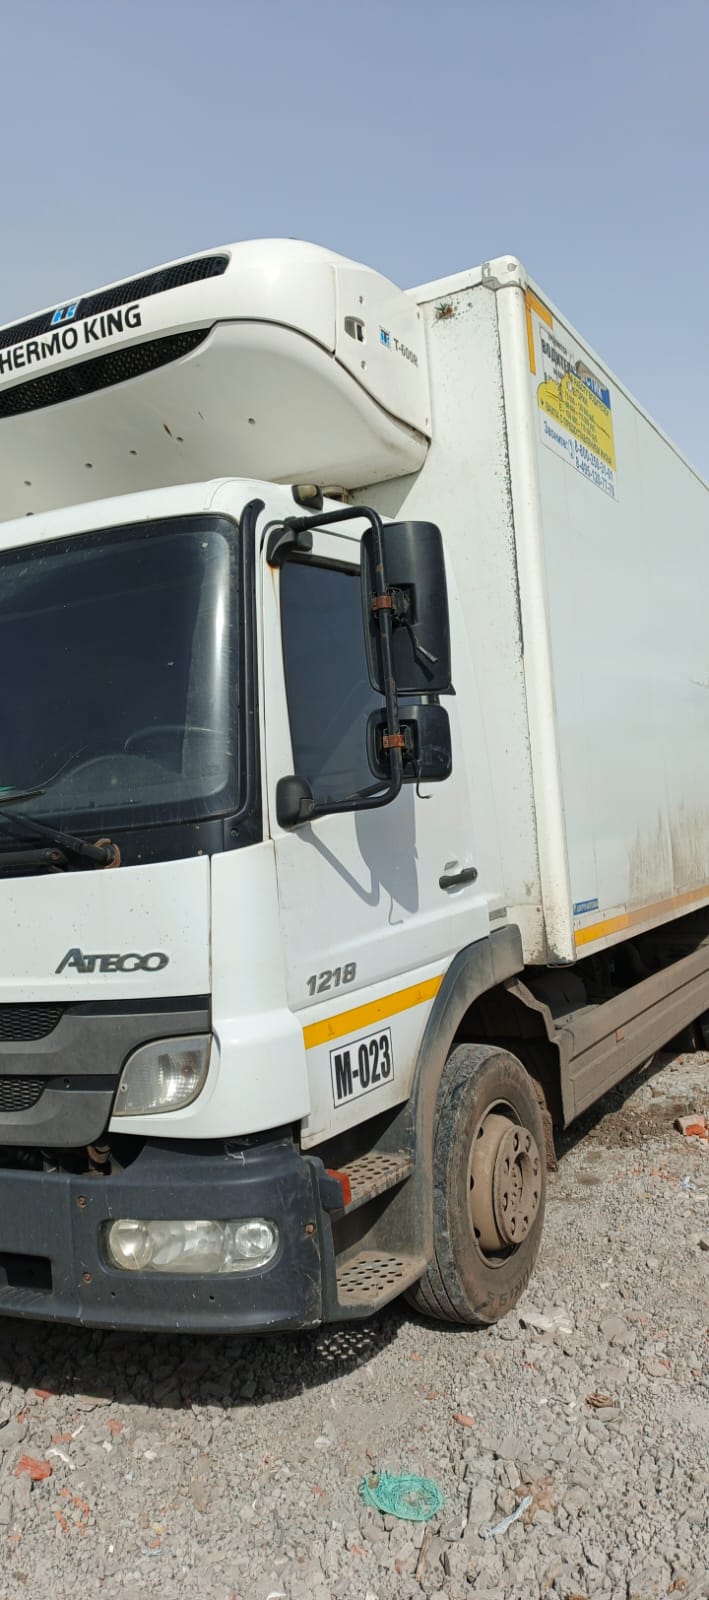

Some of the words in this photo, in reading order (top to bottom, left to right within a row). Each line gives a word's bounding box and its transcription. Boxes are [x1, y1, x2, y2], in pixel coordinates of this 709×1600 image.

[0, 327, 78, 374] HERMO
[84, 304, 142, 344] KING
[306, 962, 357, 996] 1218
[334, 1034, 391, 1100] M-023
